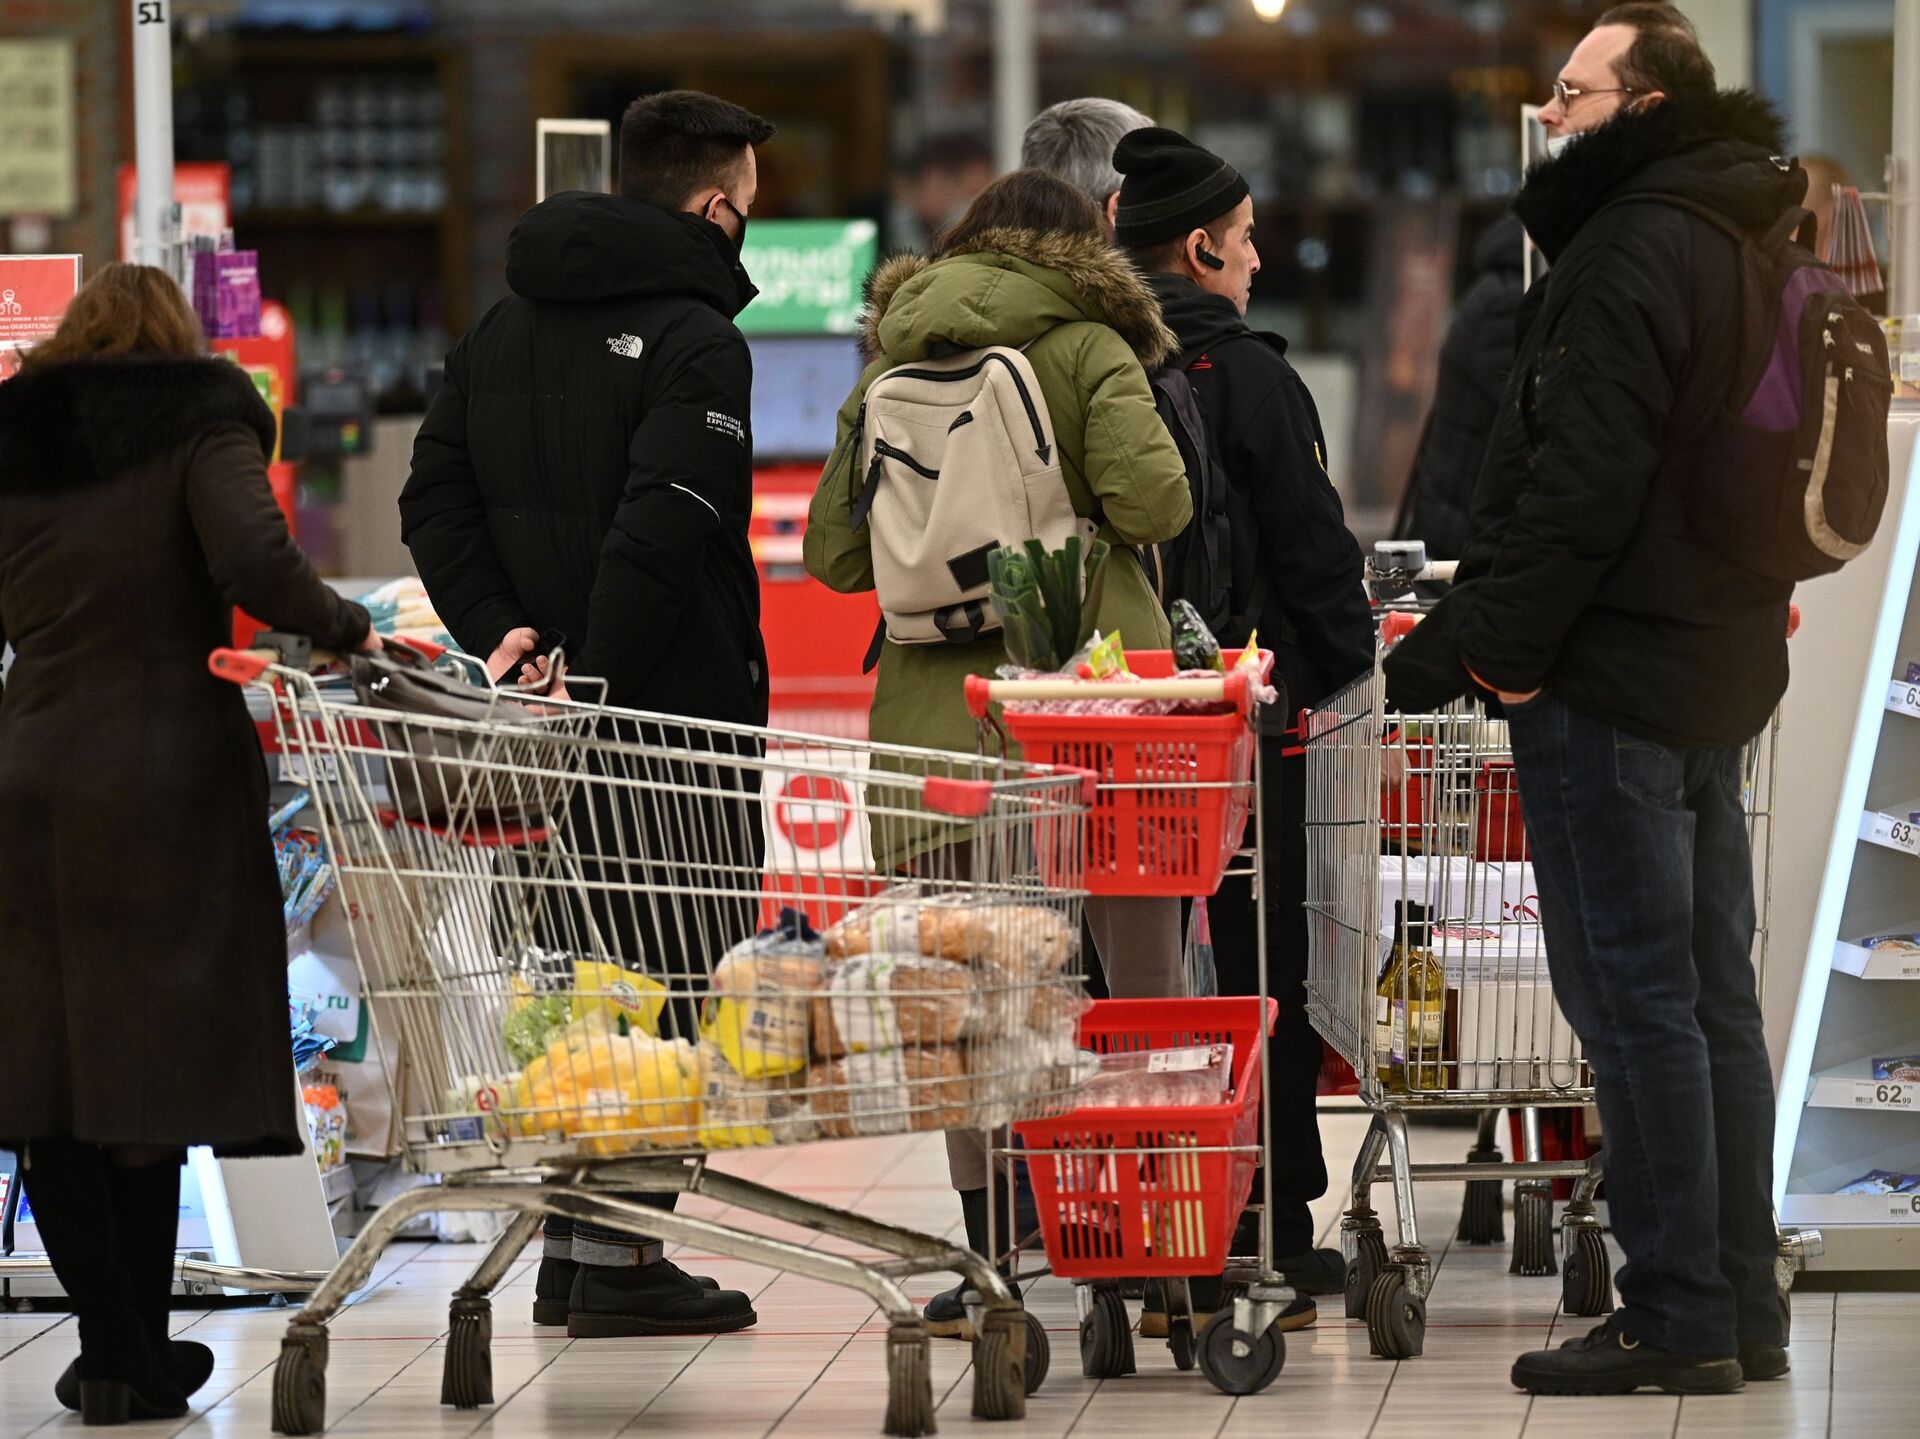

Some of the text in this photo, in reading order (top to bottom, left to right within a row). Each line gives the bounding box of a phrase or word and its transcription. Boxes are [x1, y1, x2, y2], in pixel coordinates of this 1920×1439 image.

[138, 2, 165, 25] 51
[606, 337, 633, 350] NORTH
[621, 333, 636, 343] THE
[610, 345, 629, 356] FACE
[707, 410, 728, 421] NEVER
[1891, 821, 1911, 843] 63
[328, 996, 349, 1009] ru
[1876, 1084, 1902, 1104] 62
